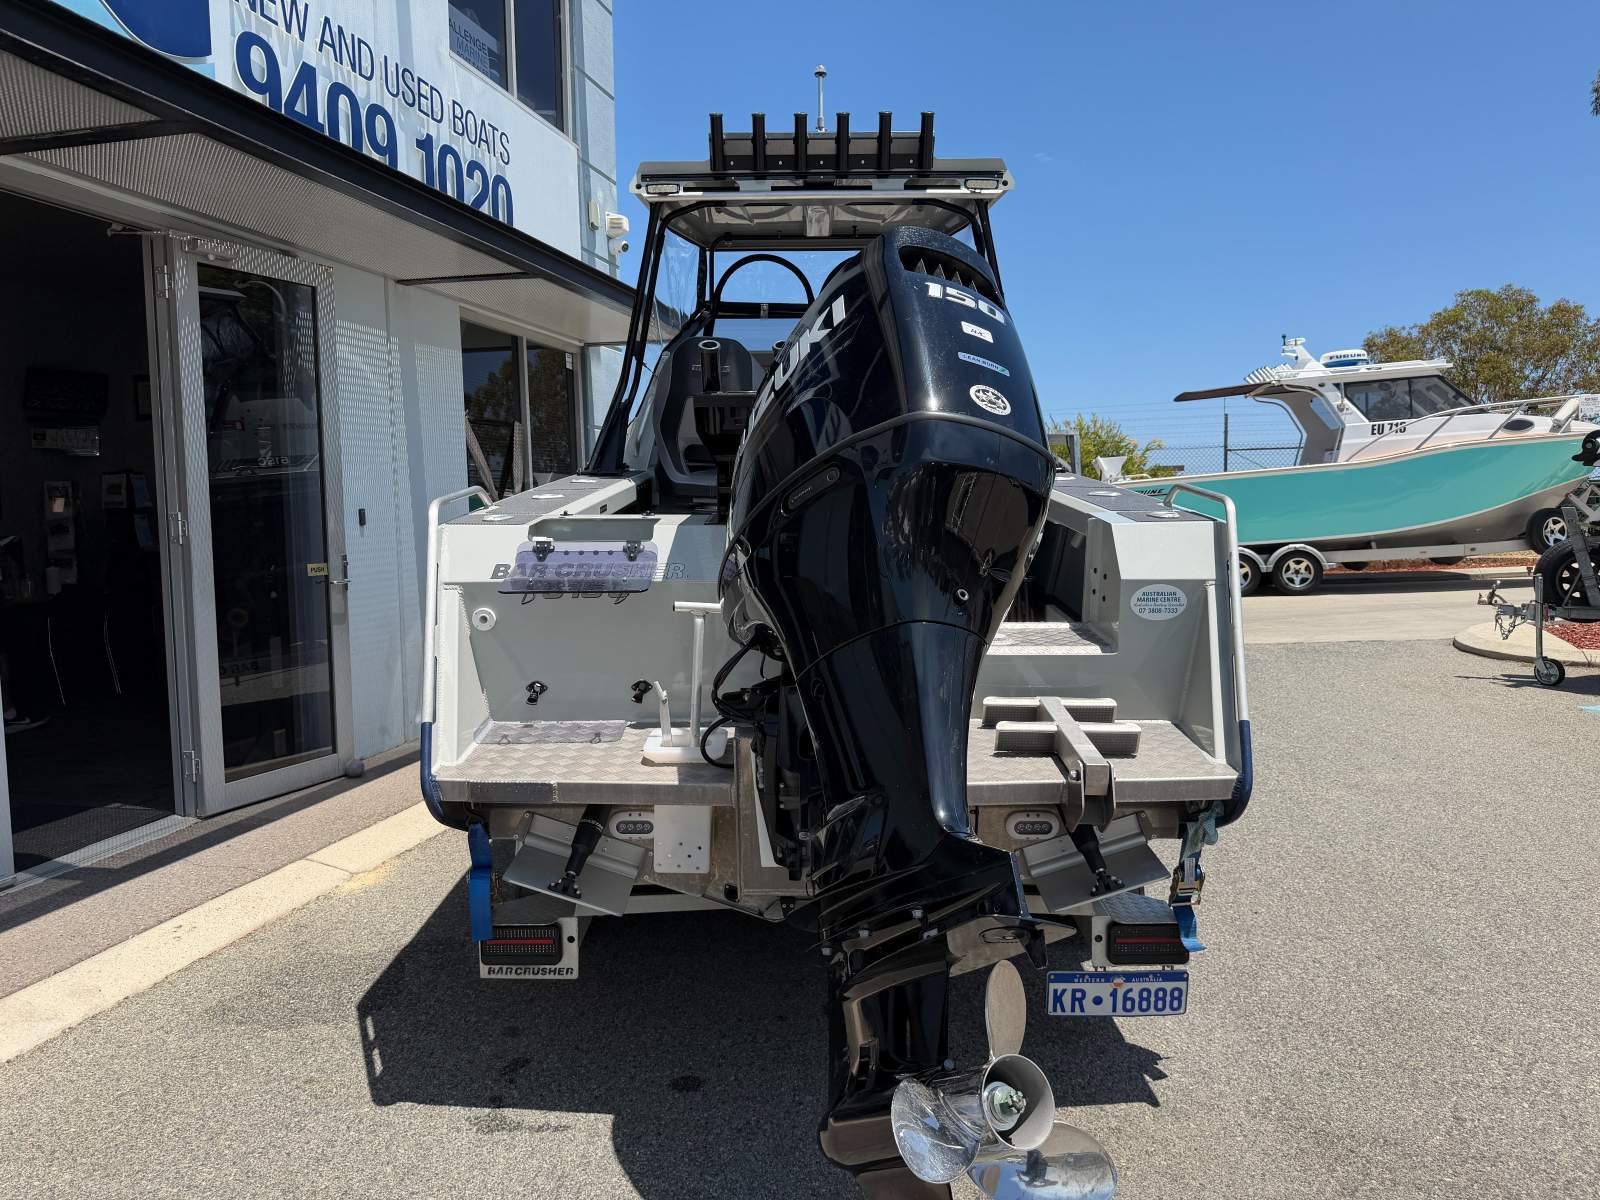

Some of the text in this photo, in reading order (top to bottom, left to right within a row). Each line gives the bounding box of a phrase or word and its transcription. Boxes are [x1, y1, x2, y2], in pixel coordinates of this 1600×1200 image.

[318, 16, 375, 81] AND
[383, 54, 444, 124] USED
[452, 99, 511, 166] BOATS
[235, 31, 514, 227] 9409 1020
[925, 282, 1005, 323] 150
[1371, 424, 1385, 435] EU
[1109, 986, 1184, 1013] 16888
